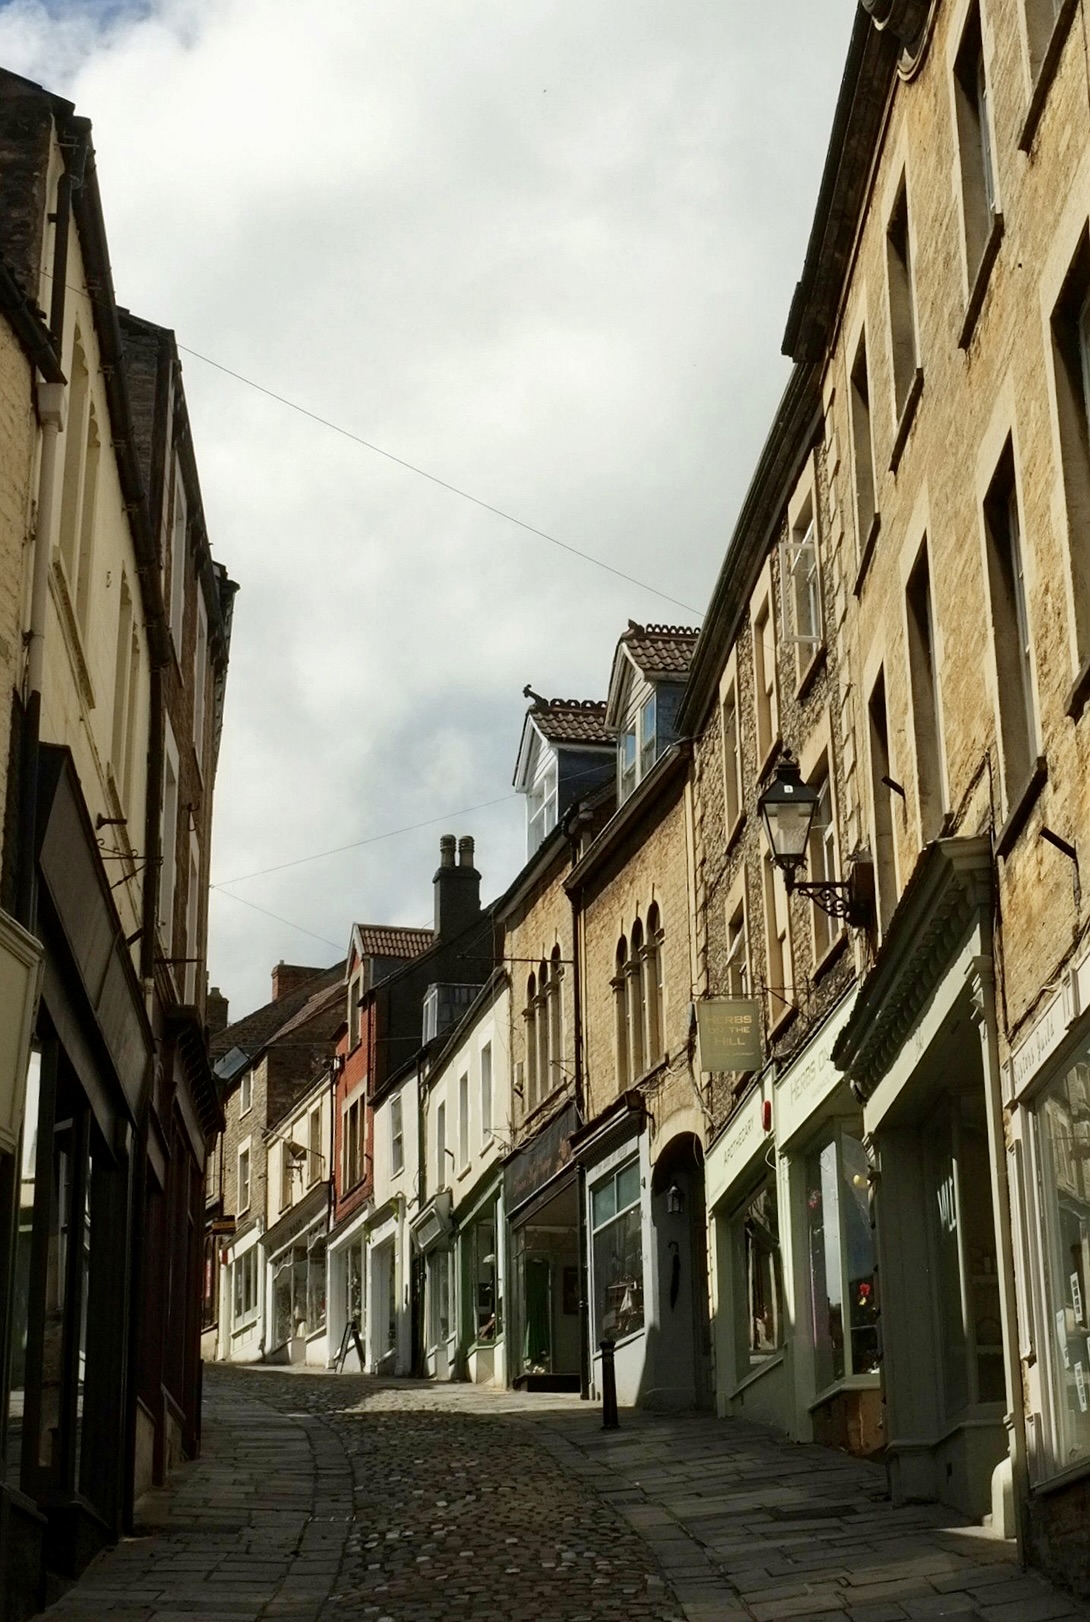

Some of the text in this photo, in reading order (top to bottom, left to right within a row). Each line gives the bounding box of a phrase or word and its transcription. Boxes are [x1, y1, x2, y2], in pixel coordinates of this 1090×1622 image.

[705, 1015, 752, 1024] HERBS
[729, 1026, 751, 1034] THE
[714, 1037, 746, 1046] HILL
[790, 1060, 816, 1106] HERBS
